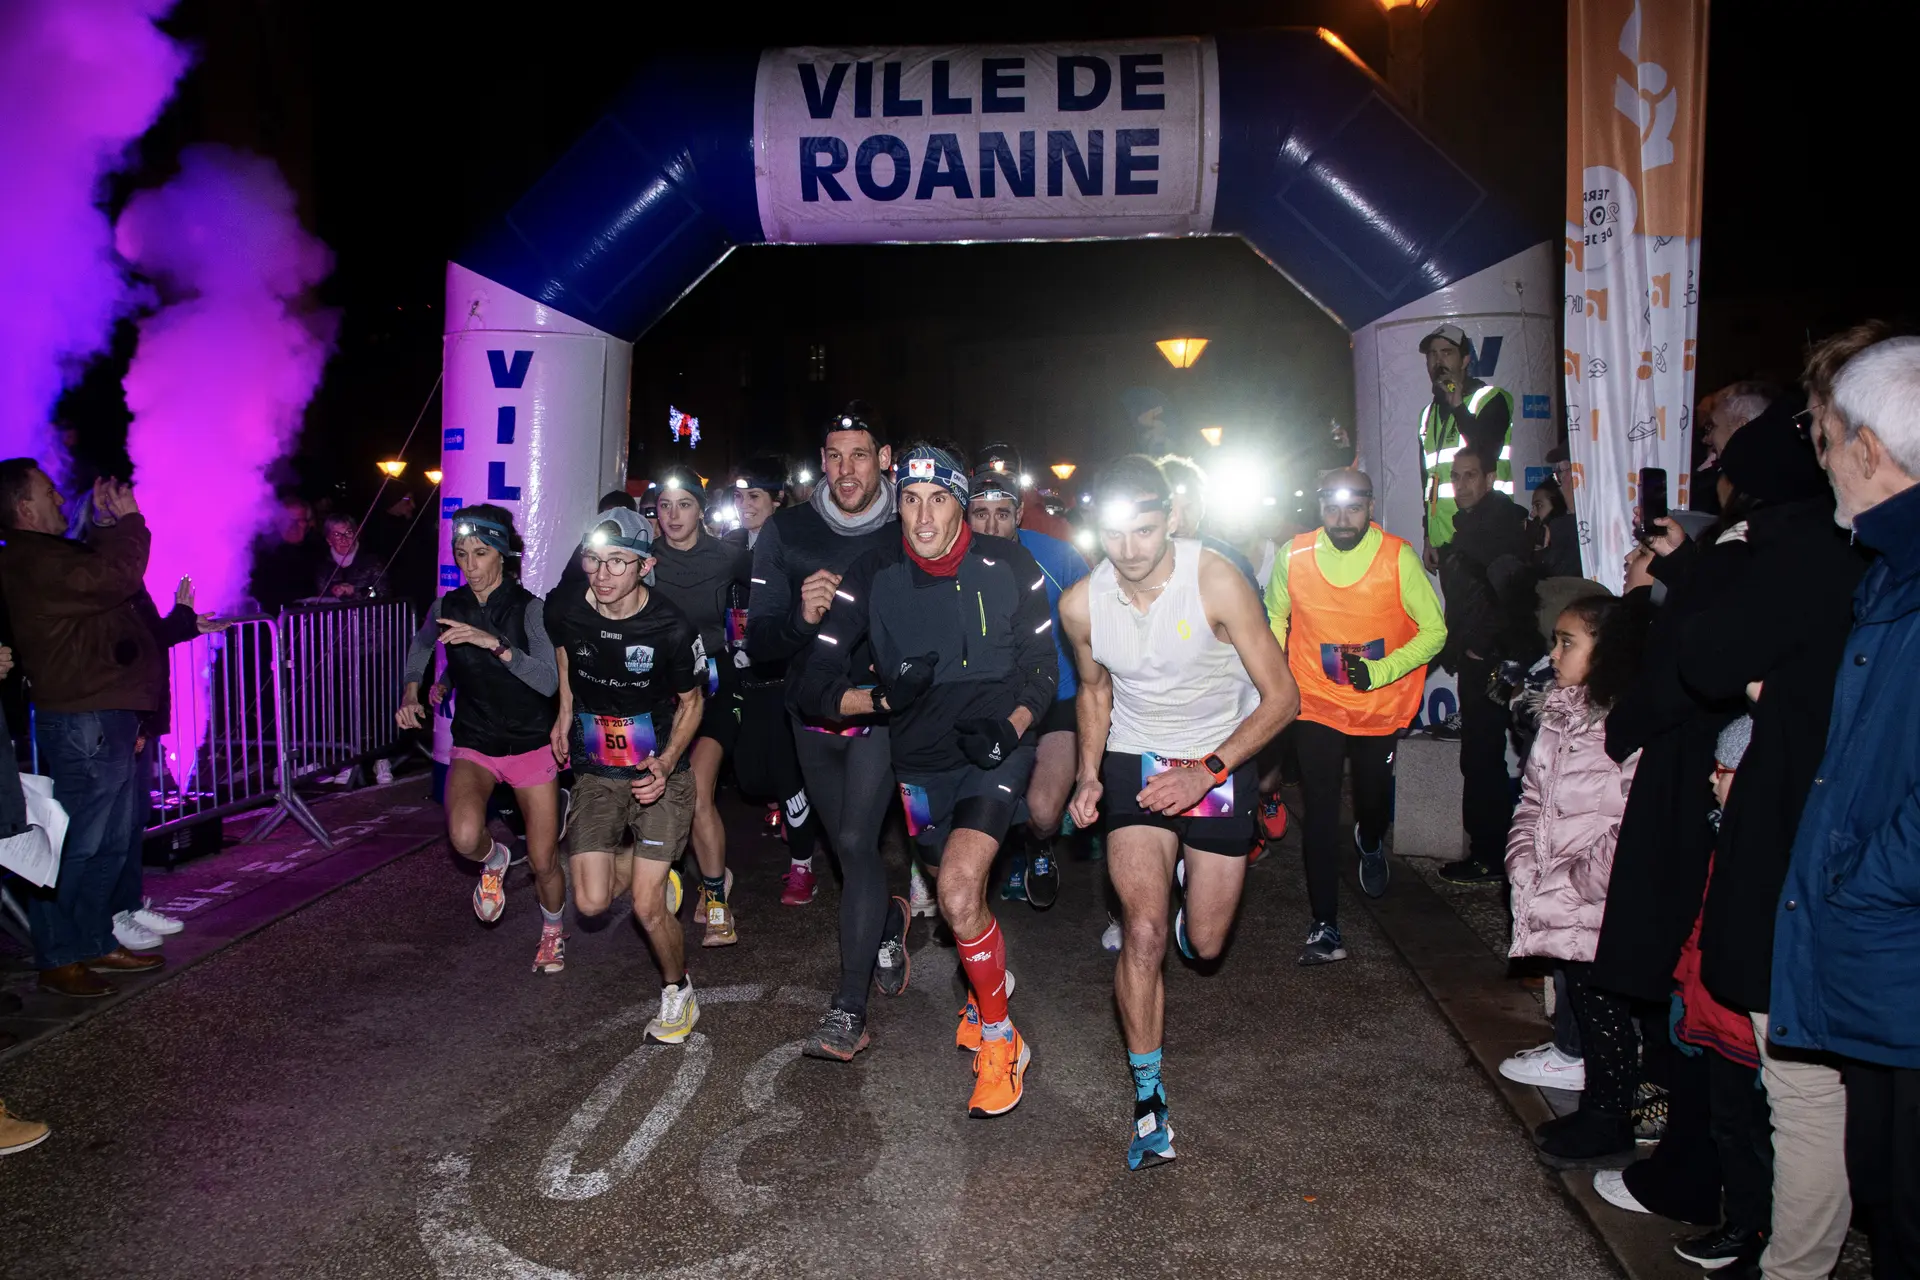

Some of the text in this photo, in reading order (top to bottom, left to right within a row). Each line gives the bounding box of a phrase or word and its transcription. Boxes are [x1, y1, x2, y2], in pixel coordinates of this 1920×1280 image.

[797, 53, 1166, 120] VILLE DE
[799, 128, 1161, 202] ROANNE
[486, 349, 535, 501] VIL
[605, 733, 627, 750] 50
[613, 717, 635, 727] 2023
[786, 787, 808, 816] NIK
